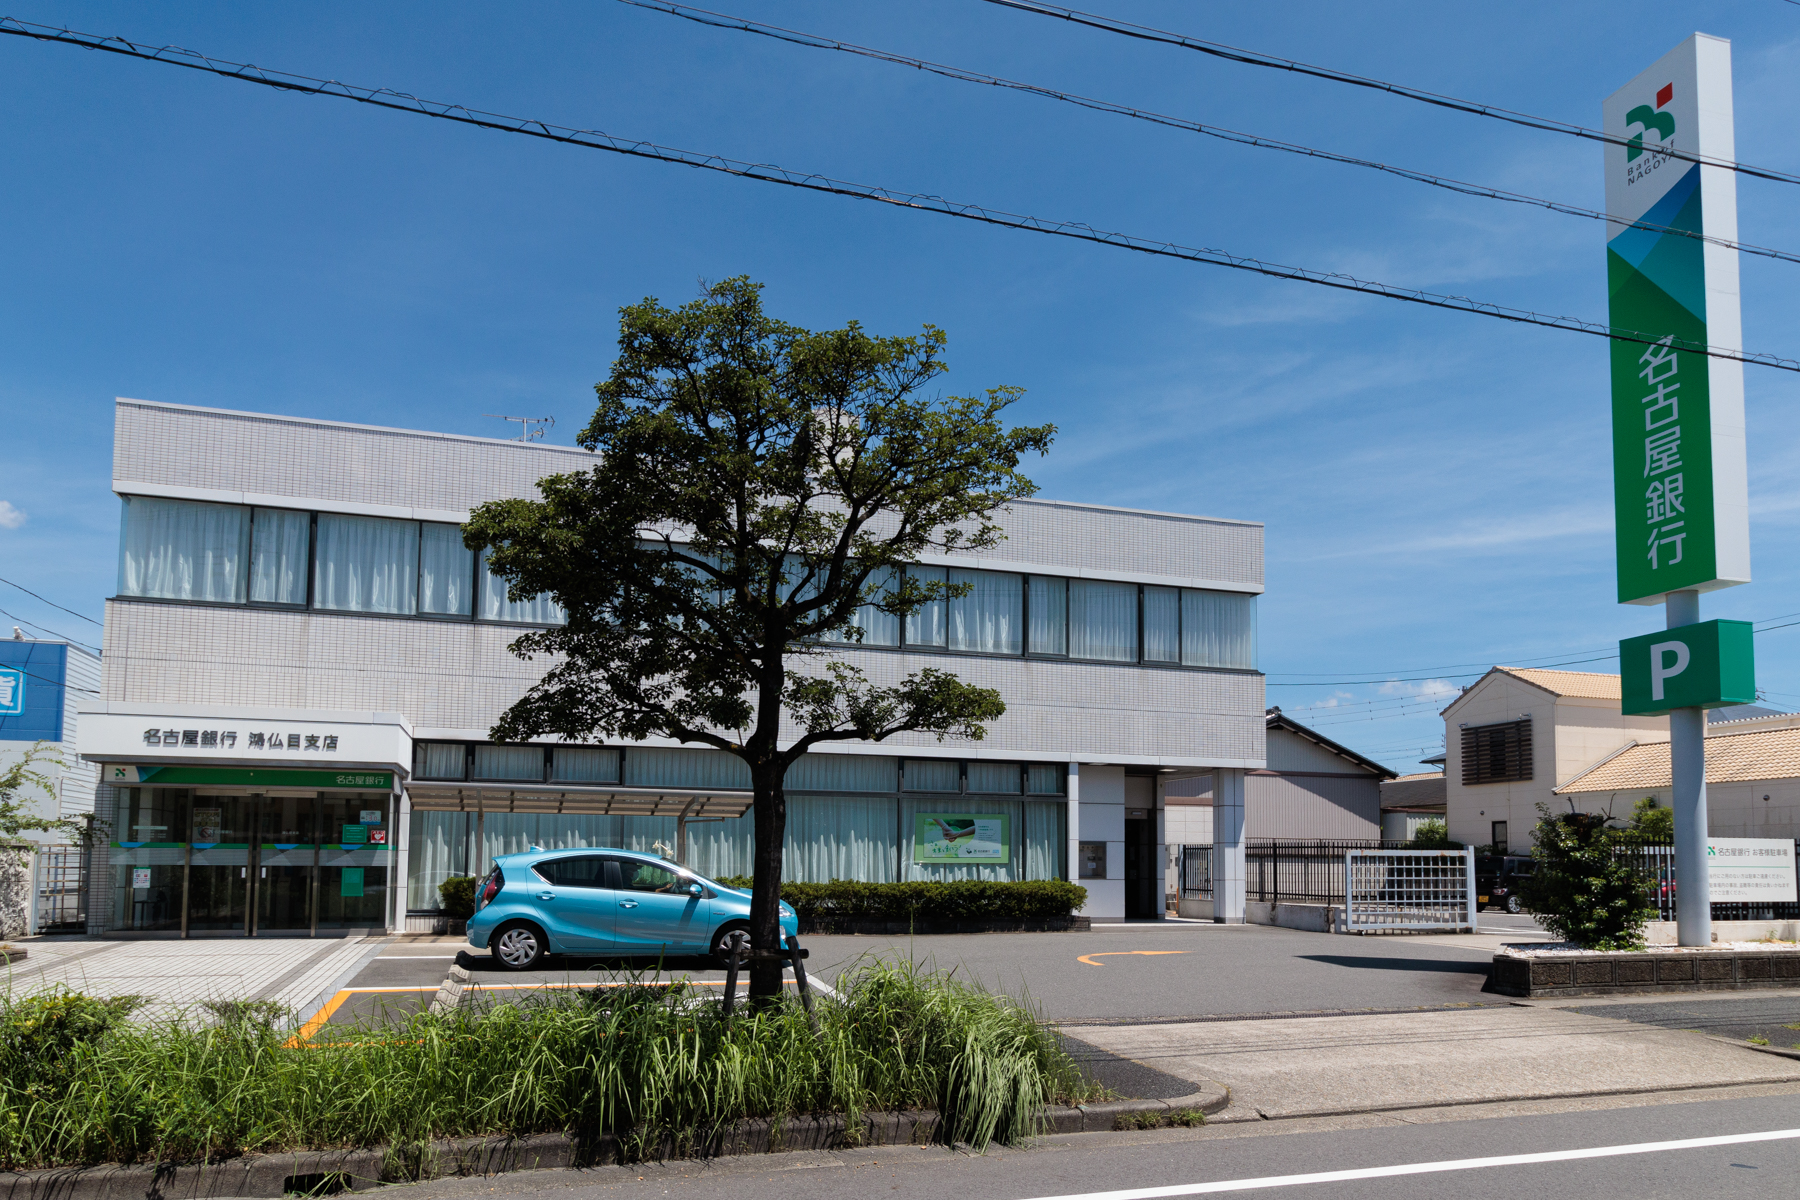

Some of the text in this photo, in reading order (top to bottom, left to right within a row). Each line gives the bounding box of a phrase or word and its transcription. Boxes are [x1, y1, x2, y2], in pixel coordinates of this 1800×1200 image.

[1627, 150, 1658, 176] Bank
[1627, 151, 1676, 187] NAGOYA
[1638, 334, 1687, 570] 名古屋銀行
[1650, 640, 1690, 701] P
[143, 728, 339, 750] 名古屋銀行 鴻仏目支店
[336, 775, 385, 785] 名古屋銀行
[1718, 848, 1750, 856] 名古屋銀行
